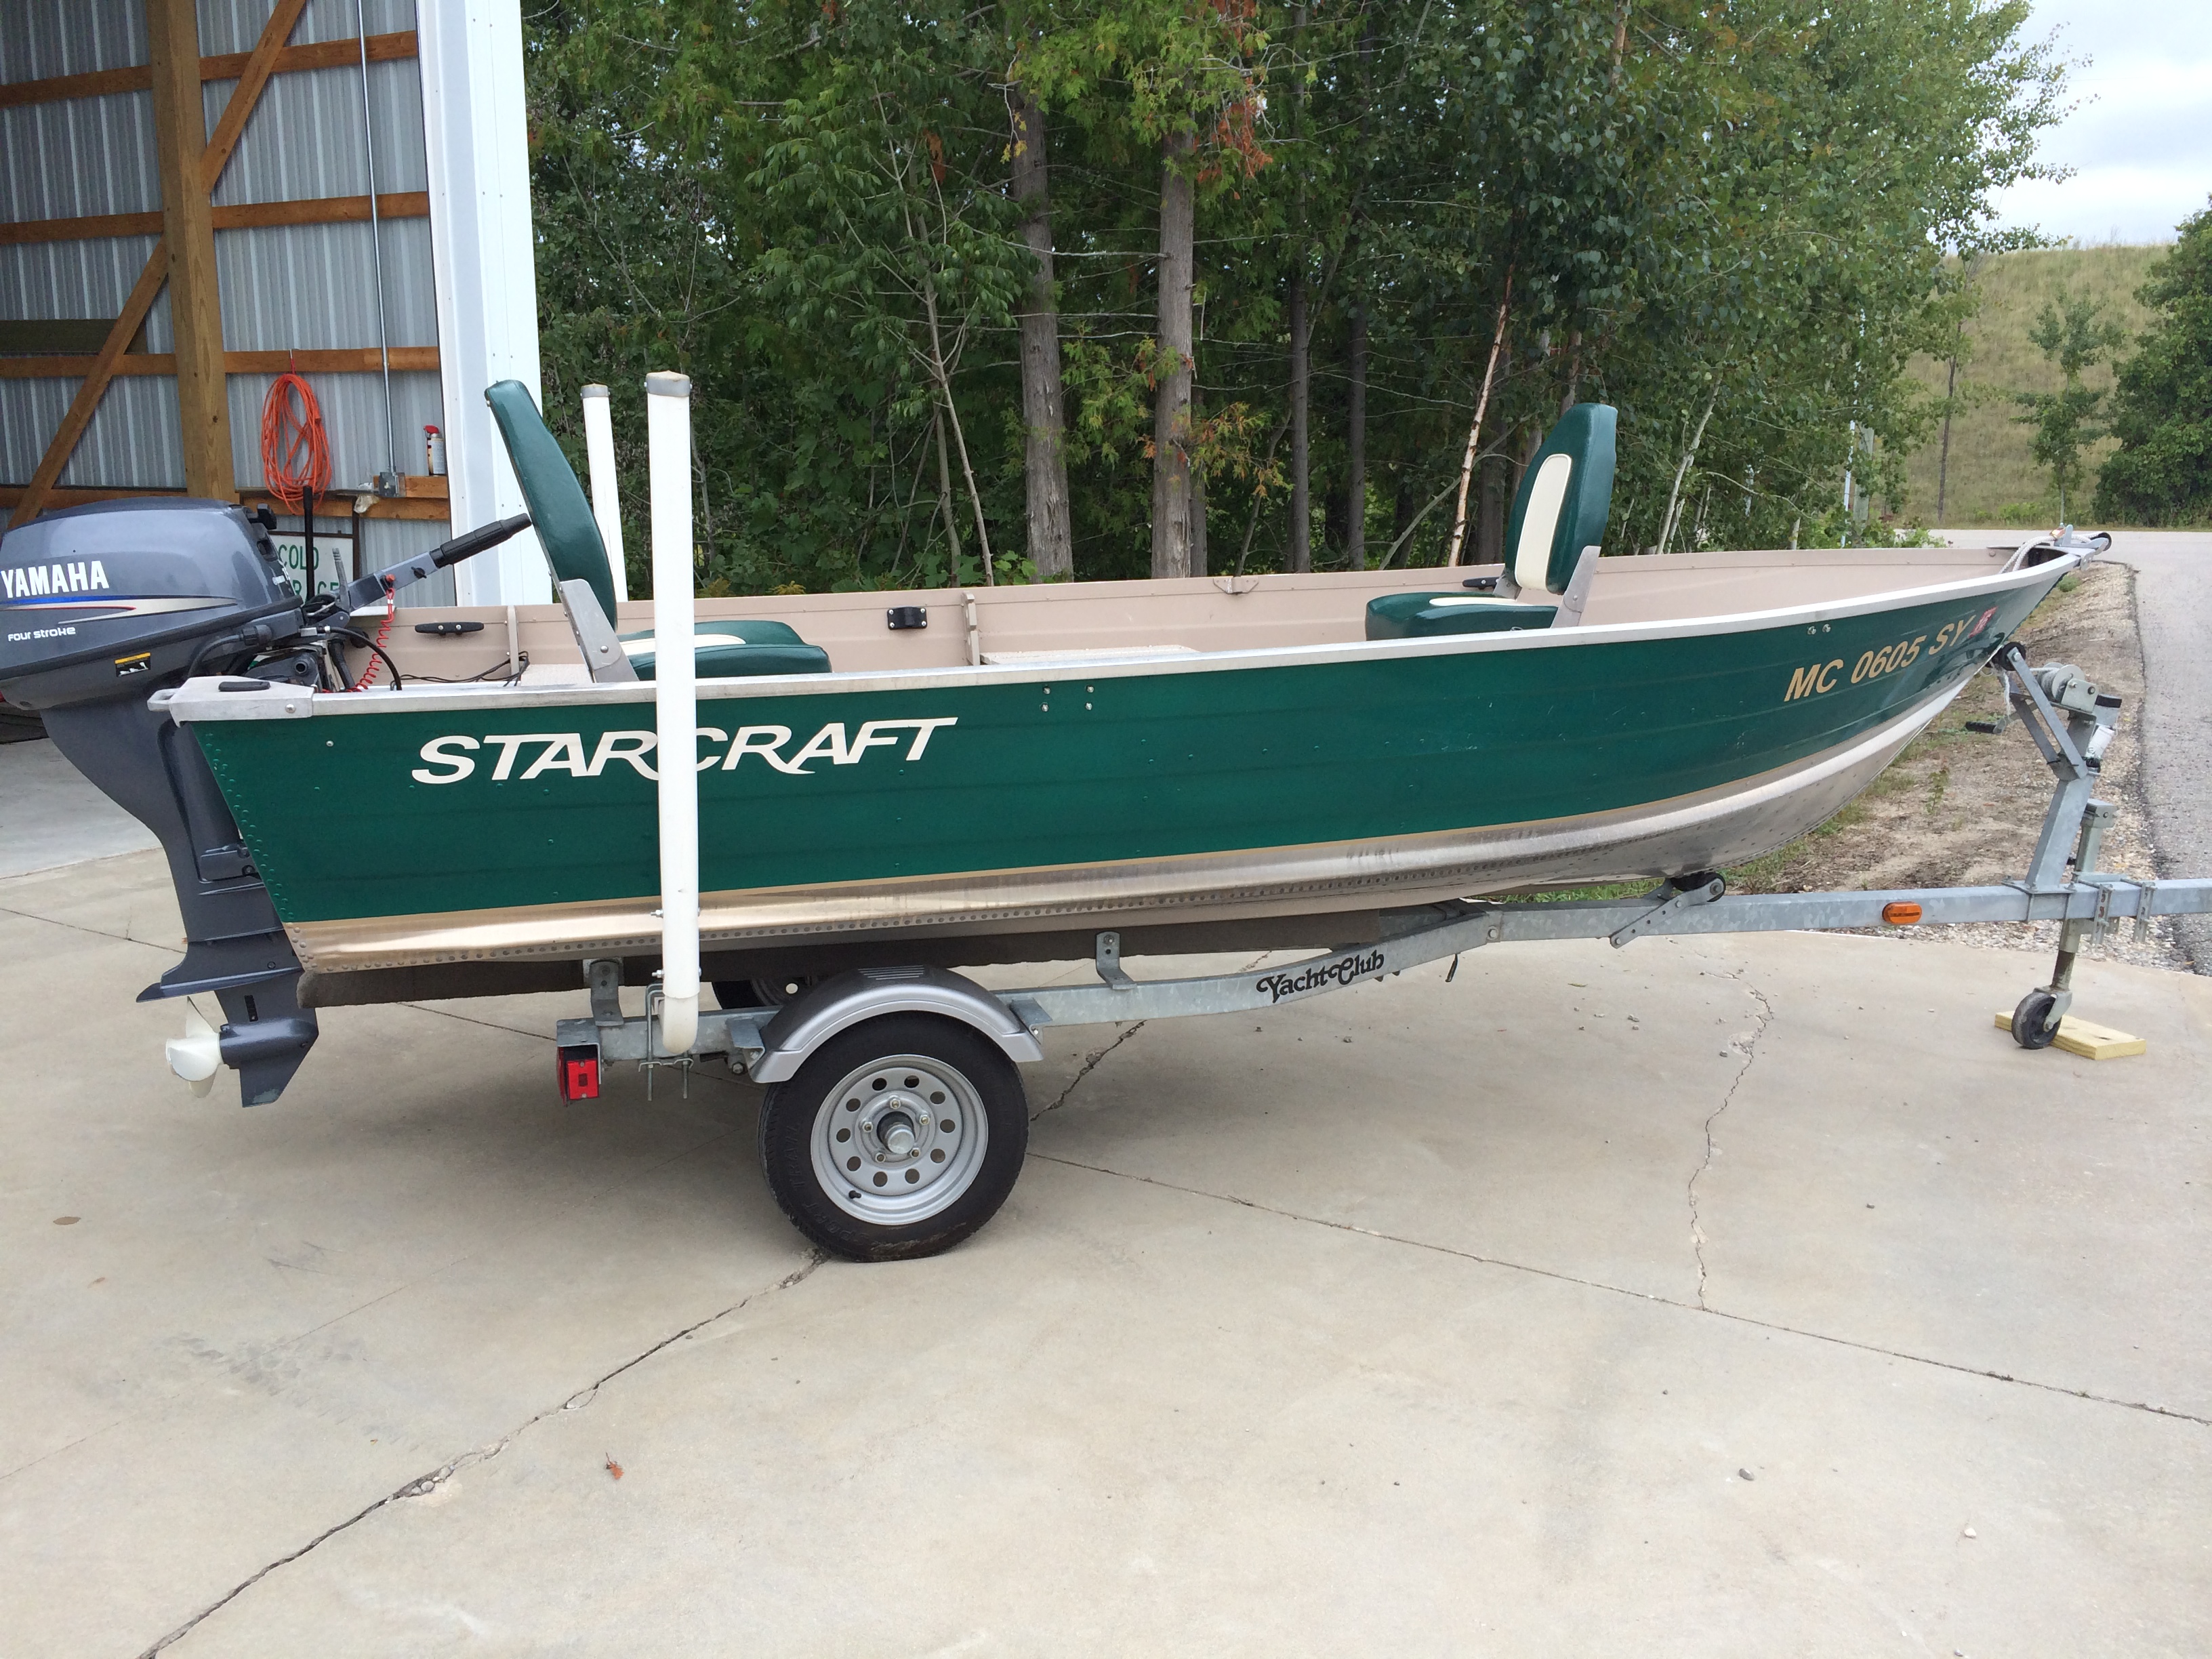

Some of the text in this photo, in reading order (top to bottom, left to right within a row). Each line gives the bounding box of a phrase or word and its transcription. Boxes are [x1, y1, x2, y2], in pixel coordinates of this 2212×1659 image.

[1, 560, 109, 598] YAMAHA
[279, 544, 319, 571] COLD
[1784, 615, 1976, 702] MC 0605 SY
[1256, 949, 1385, 1003] Yacht Club
